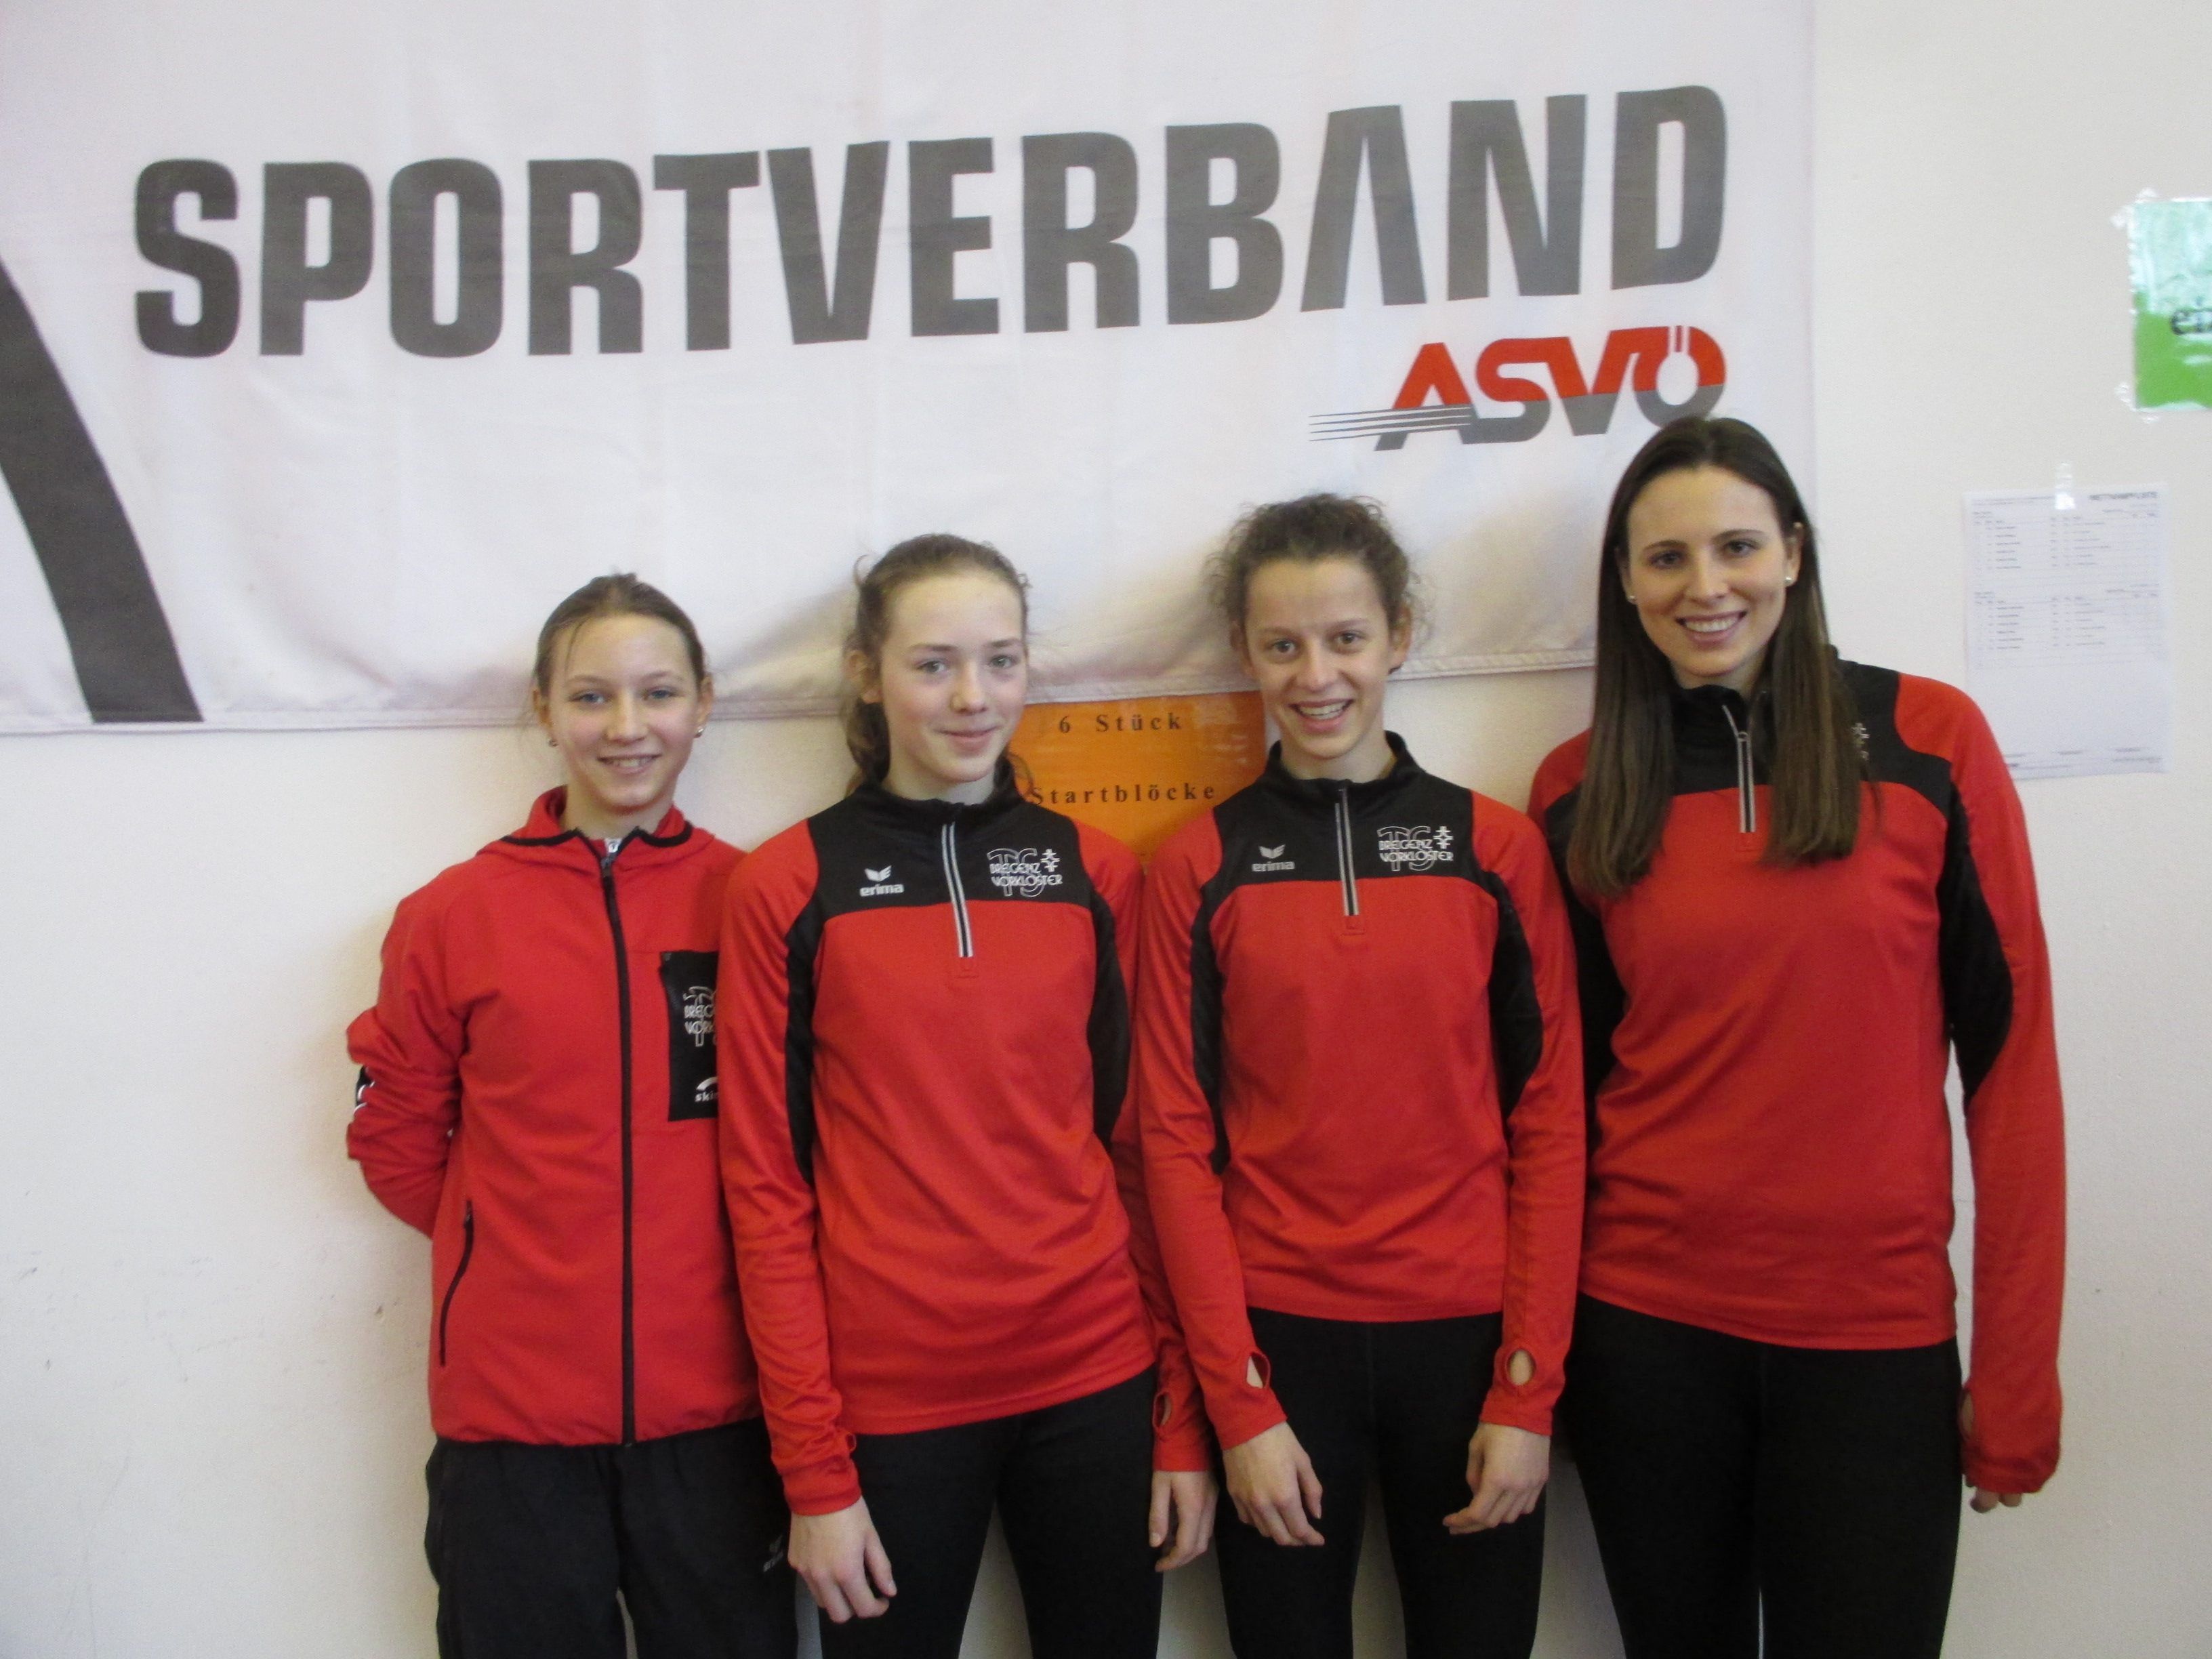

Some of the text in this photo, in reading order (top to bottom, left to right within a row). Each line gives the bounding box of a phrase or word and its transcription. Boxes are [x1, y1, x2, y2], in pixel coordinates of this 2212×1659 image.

[134, 85, 1728, 358] SPORTVERBAND
[1373, 325, 1727, 451] ASVÖ
[1058, 712, 1183, 733] 6 Stück
[1031, 782, 1216, 805] Startblöcke
[1251, 861, 1295, 872] erima
[859, 883, 905, 897] erima
